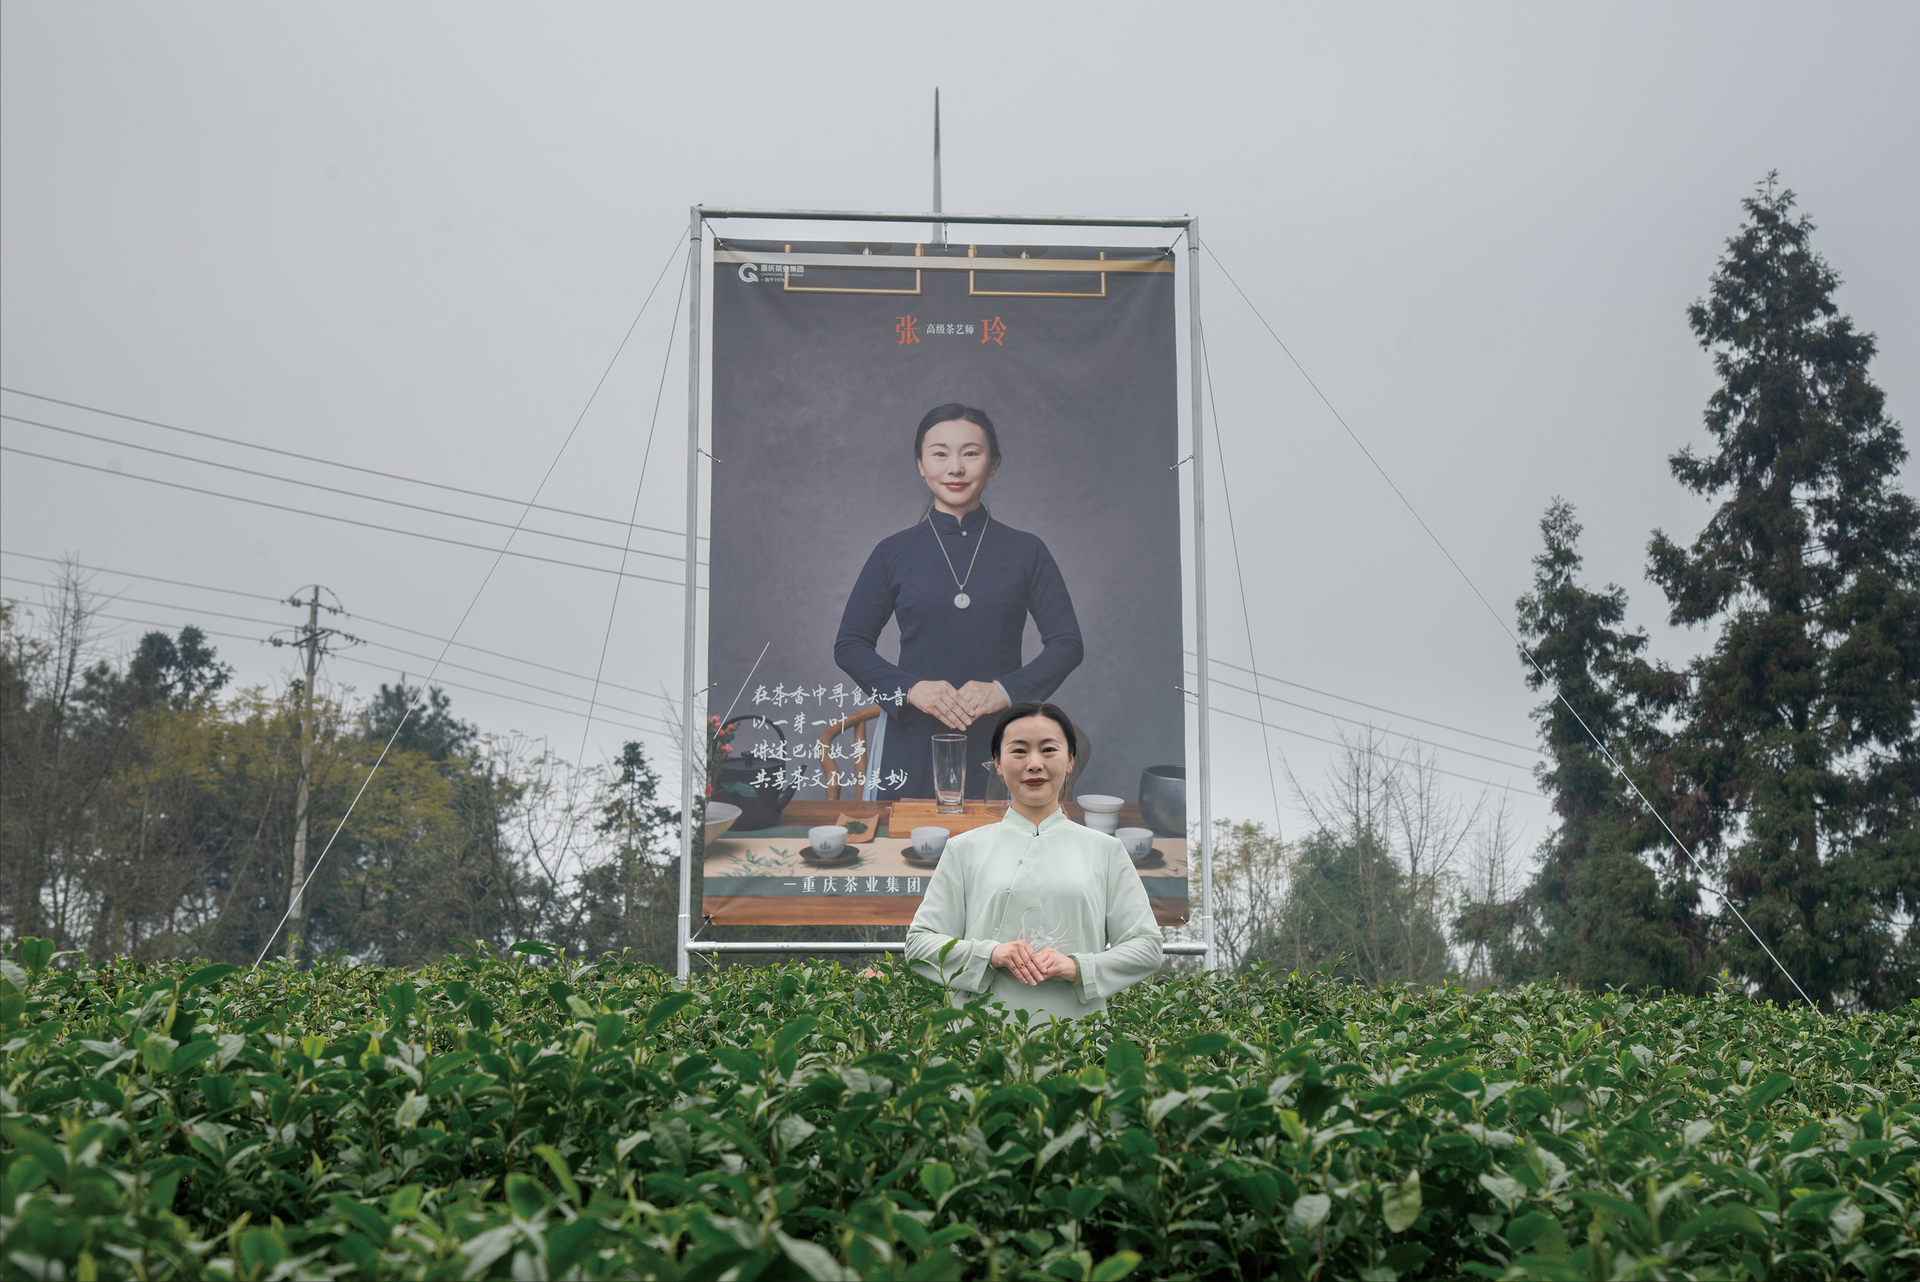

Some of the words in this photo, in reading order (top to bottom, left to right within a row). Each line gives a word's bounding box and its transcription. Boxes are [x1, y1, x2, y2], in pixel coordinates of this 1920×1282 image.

[895, 315, 921, 345] 张
[926, 323, 975, 335] 高级茶艺师
[980, 315, 1007, 346] 玲
[751, 682, 907, 707] 在茶香中寻觅知音
[752, 711, 849, 734] 以一芽一叶
[751, 739, 867, 764] 讲述巴渝故事
[749, 765, 908, 791] 共享茶文化的美妙
